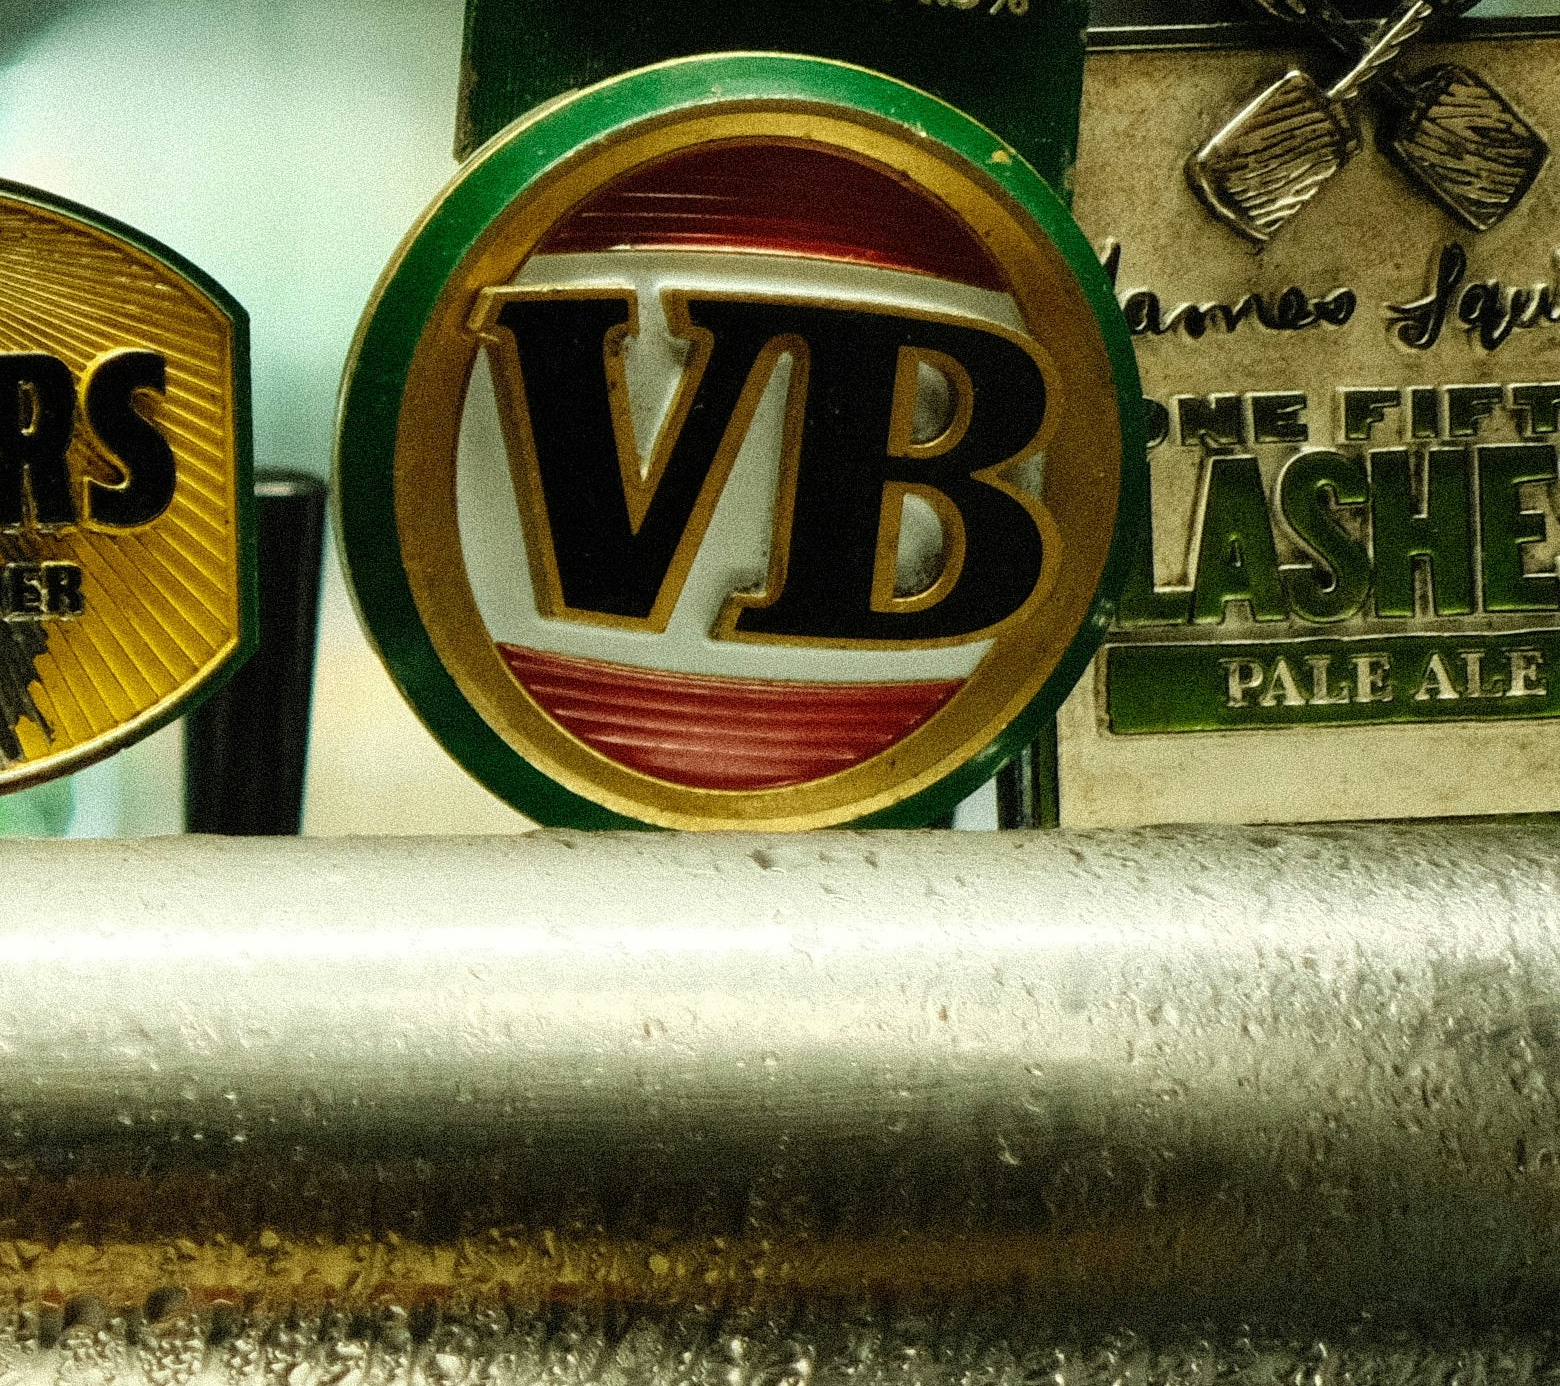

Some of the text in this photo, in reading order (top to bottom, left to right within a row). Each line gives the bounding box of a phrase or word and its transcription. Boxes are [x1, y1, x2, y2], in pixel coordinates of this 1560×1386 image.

[1100, 237, 1560, 351] ames Squ
[470, 284, 1064, 650] VB
[1117, 443, 1560, 625] LASHE
[1223, 646, 1548, 708] PALE ALE
